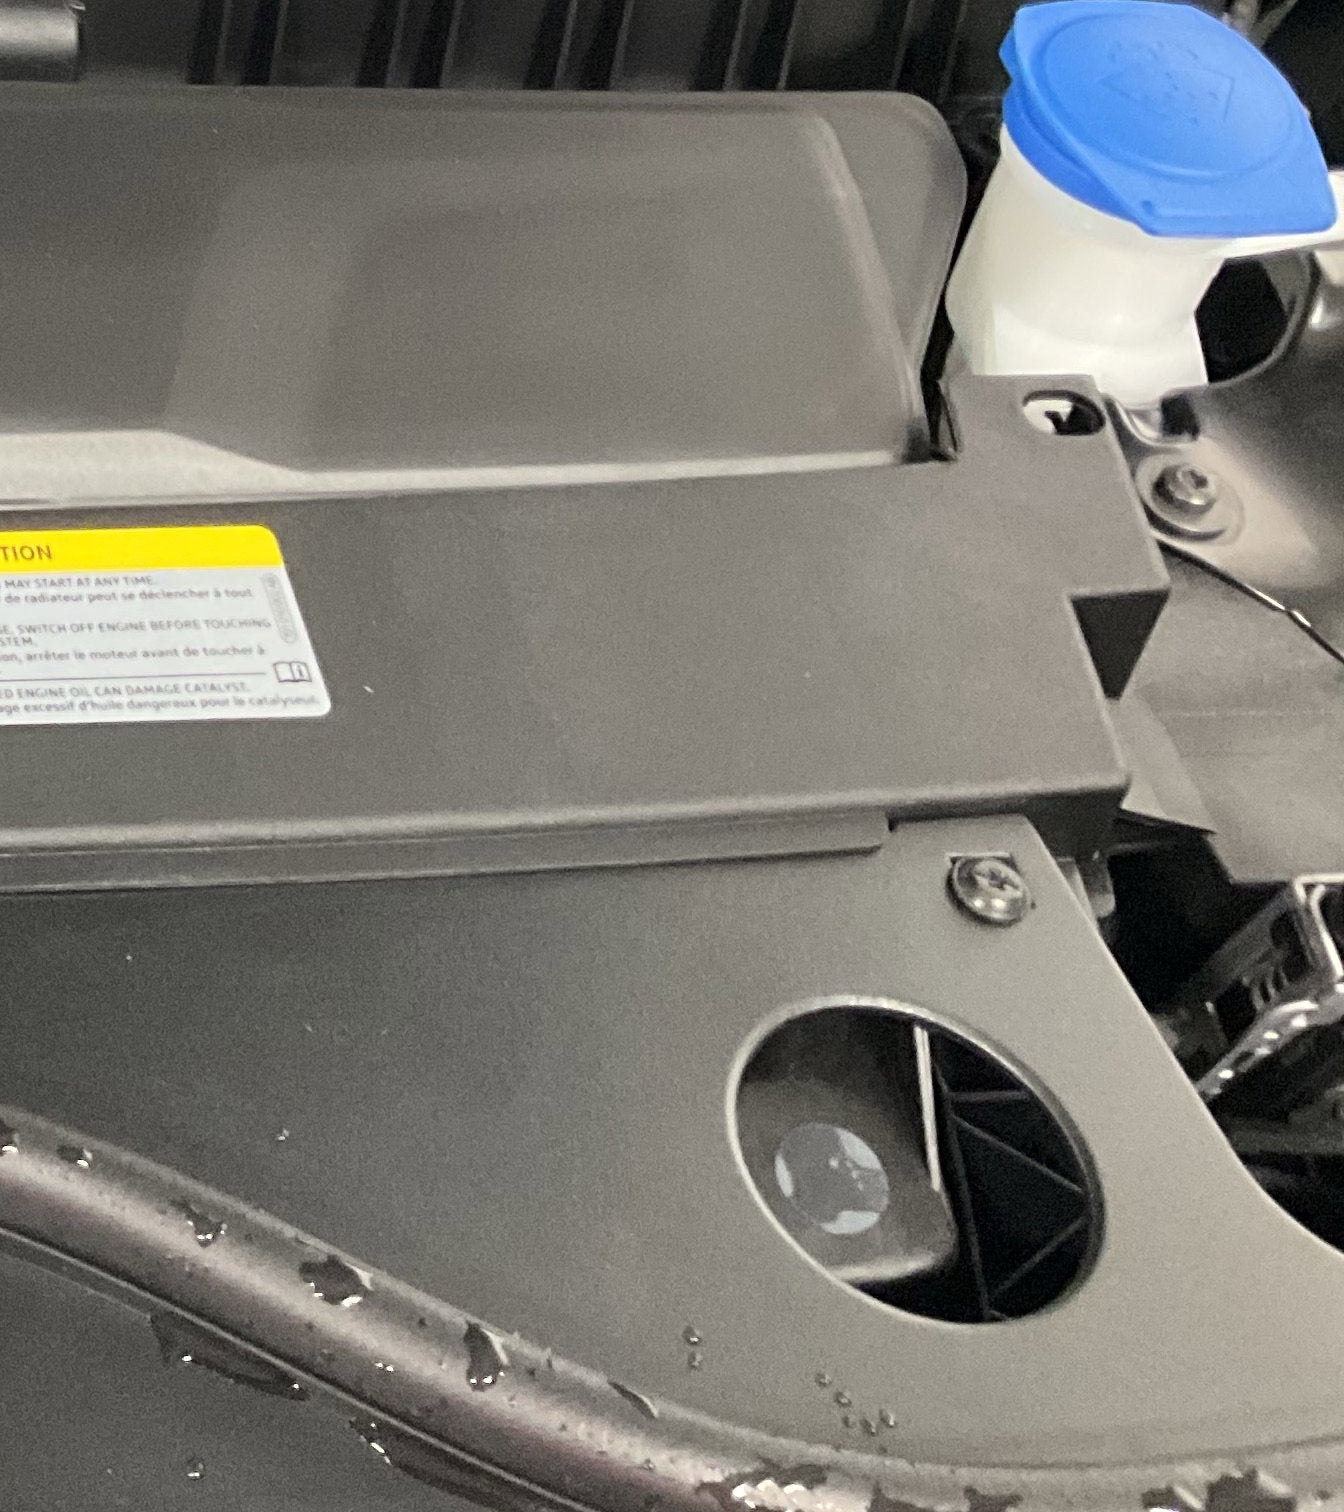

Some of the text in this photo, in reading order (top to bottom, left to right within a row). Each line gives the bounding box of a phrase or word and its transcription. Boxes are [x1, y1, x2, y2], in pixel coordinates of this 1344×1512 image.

[4, 579, 30, 589] MAY
[34, 578, 72, 588] START
[77, 577, 90, 587] AT
[94, 576, 121, 586] ANY
[4, 593, 21, 604] de
[24, 592, 83, 603] radiateur
[88, 591, 118, 603] peut
[122, 591, 136, 600] se
[139, 589, 209, 600] déclencher
[214, 588, 221, 598] à
[224, 588, 252, 598] tout
[17, 623, 67, 634] SWITCH
[70, 623, 94, 633] OFF
[98, 621, 146, 632] ENGINE
[150, 620, 201, 631] BEFORE
[204, 618, 272, 629] TOUCHING
[26, 649, 69, 660] arrêter
[74, 649, 86, 660] le
[89, 649, 137, 659] moteur
[142, 647, 179, 658] avant
[183, 646, 199, 657] de
[202, 646, 253, 656] toucher
[257, 645, 265, 655] à
[17, 688, 65, 699] ENGINE
[69, 687, 88, 697] OIL
[95, 685, 122, 696] CAN
[126, 684, 180, 695] DAMAGE
[24, 701, 74, 713] excessif
[126, 699, 195, 712] dangereux
[200, 699, 229, 710] pour
[234, 696, 246, 707] le
